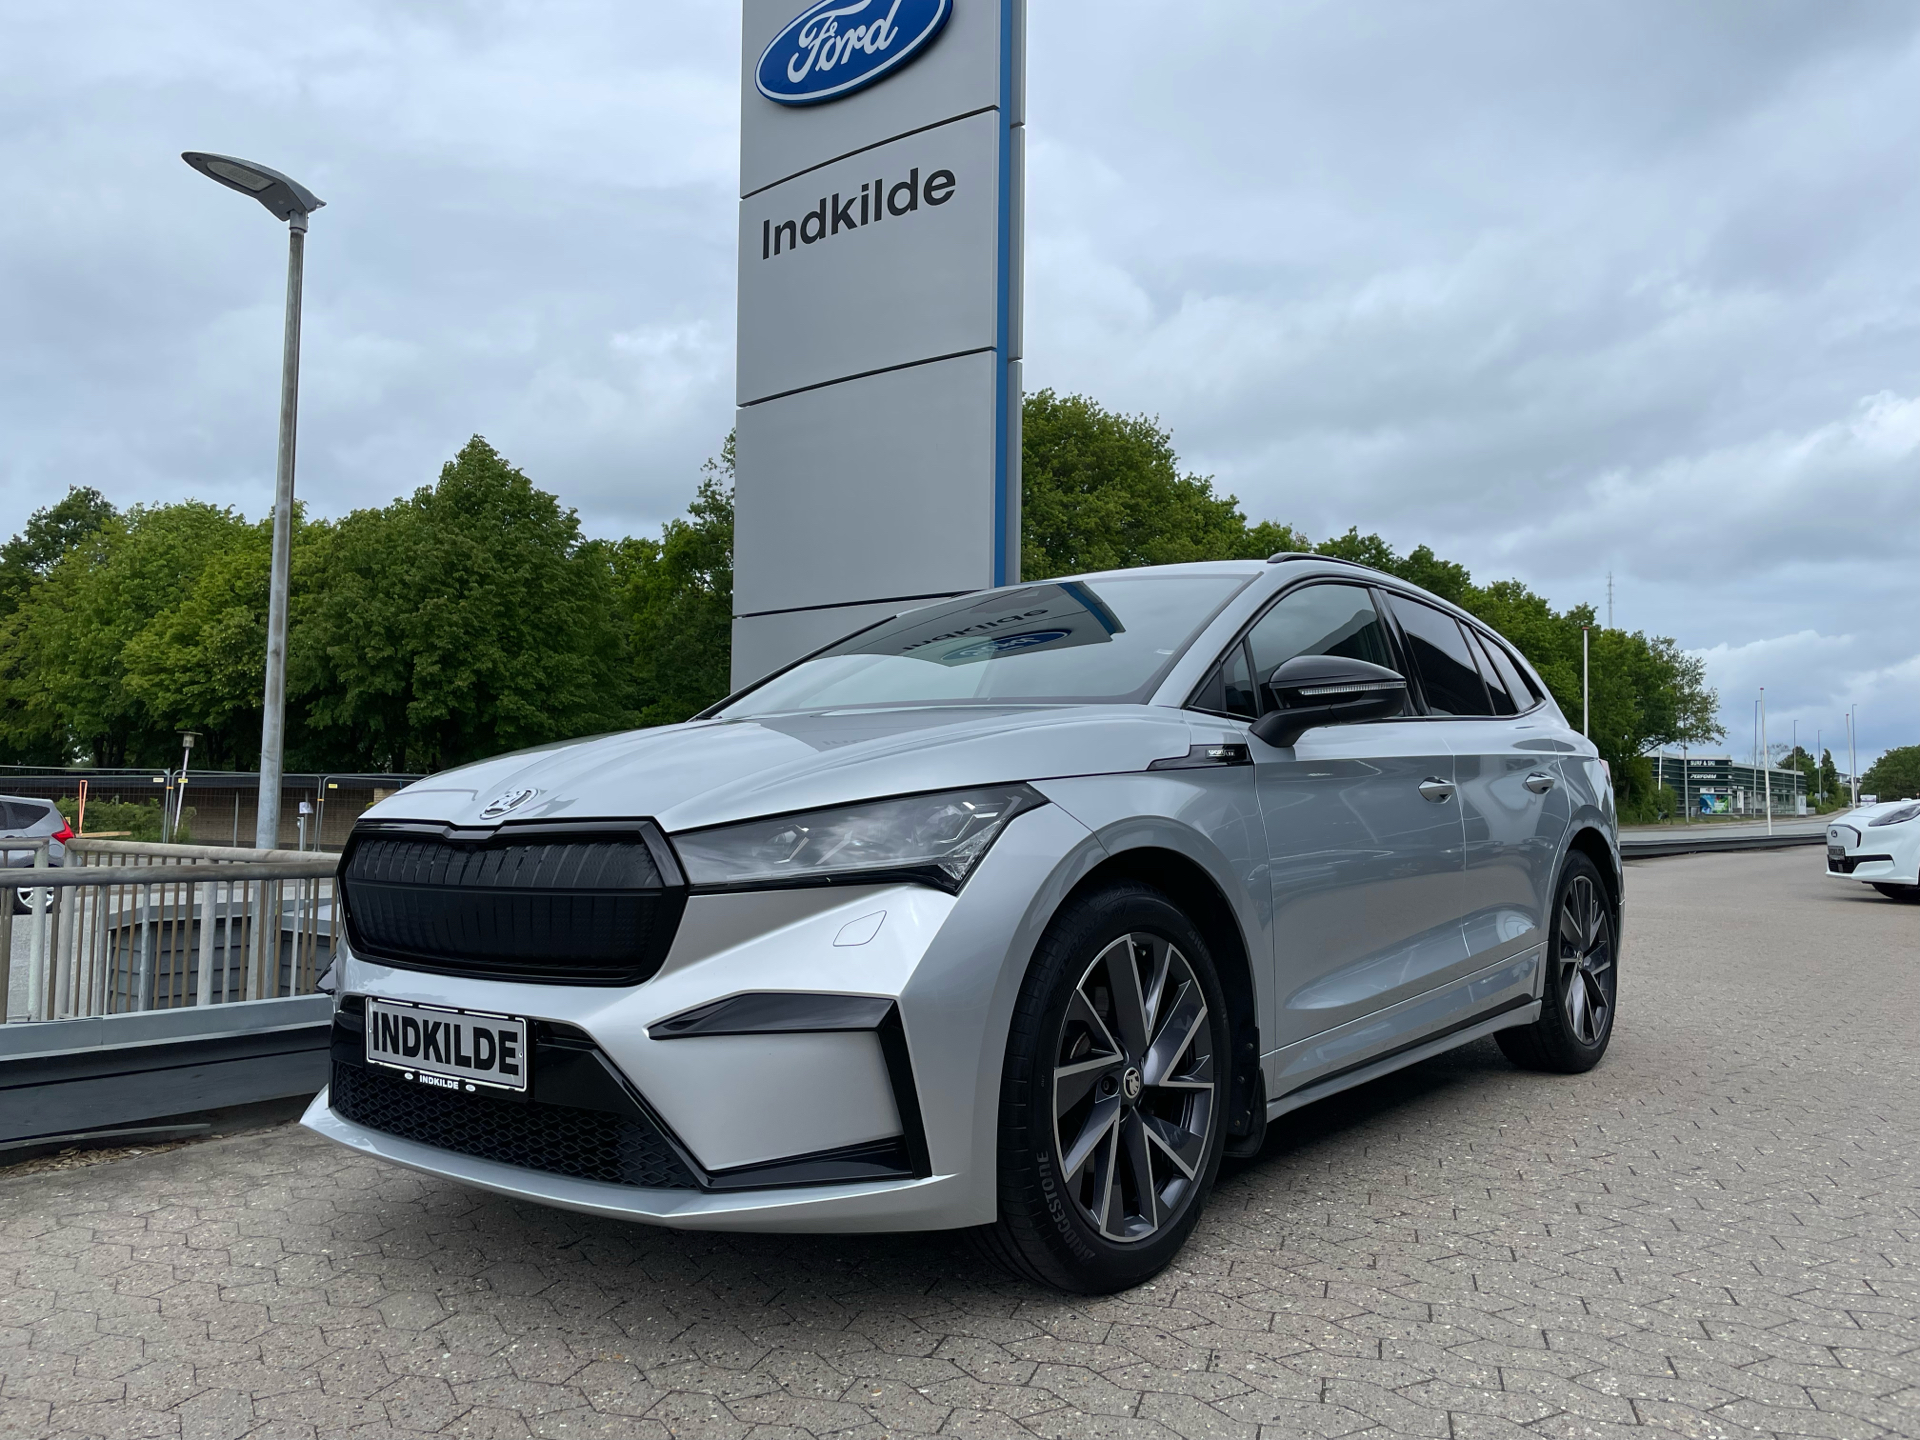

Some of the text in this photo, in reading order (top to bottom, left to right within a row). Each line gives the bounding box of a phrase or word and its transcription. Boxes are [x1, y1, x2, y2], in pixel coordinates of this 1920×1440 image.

[786, 0, 899, 83] Ford
[762, 167, 957, 260] Indkilde
[373, 1011, 519, 1076] INDKILDE
[419, 1075, 459, 1090] INDKILDE
[1035, 1150, 1097, 1262] BRIDGESTONE
